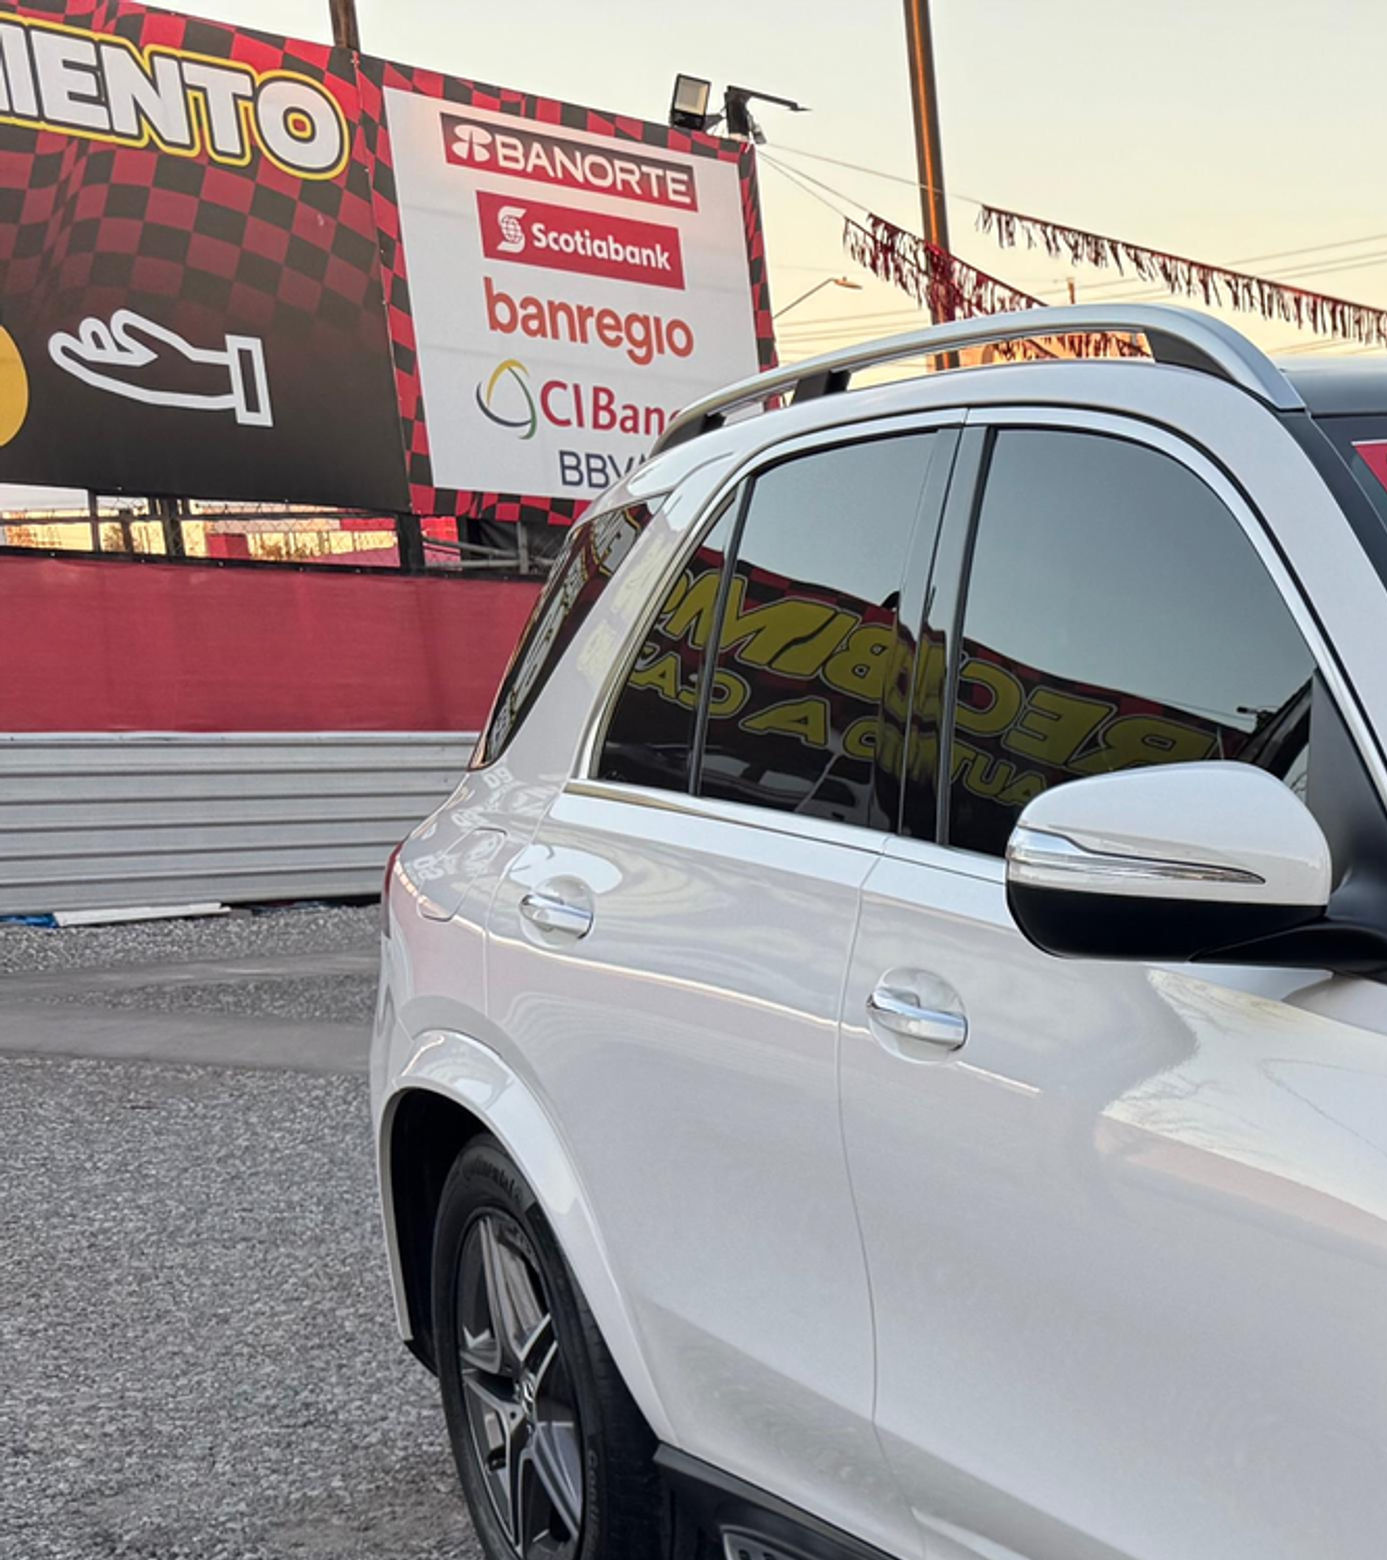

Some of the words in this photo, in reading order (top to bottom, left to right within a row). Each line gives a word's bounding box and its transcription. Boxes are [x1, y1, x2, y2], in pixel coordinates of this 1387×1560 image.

[0, 18, 345, 175] IENTO
[494, 132, 692, 205] BANORTE
[531, 221, 672, 271] Scotiabank
[483, 276, 694, 365] banregio
[540, 379, 681, 436] CIBan
[559, 450, 646, 489] BBV
